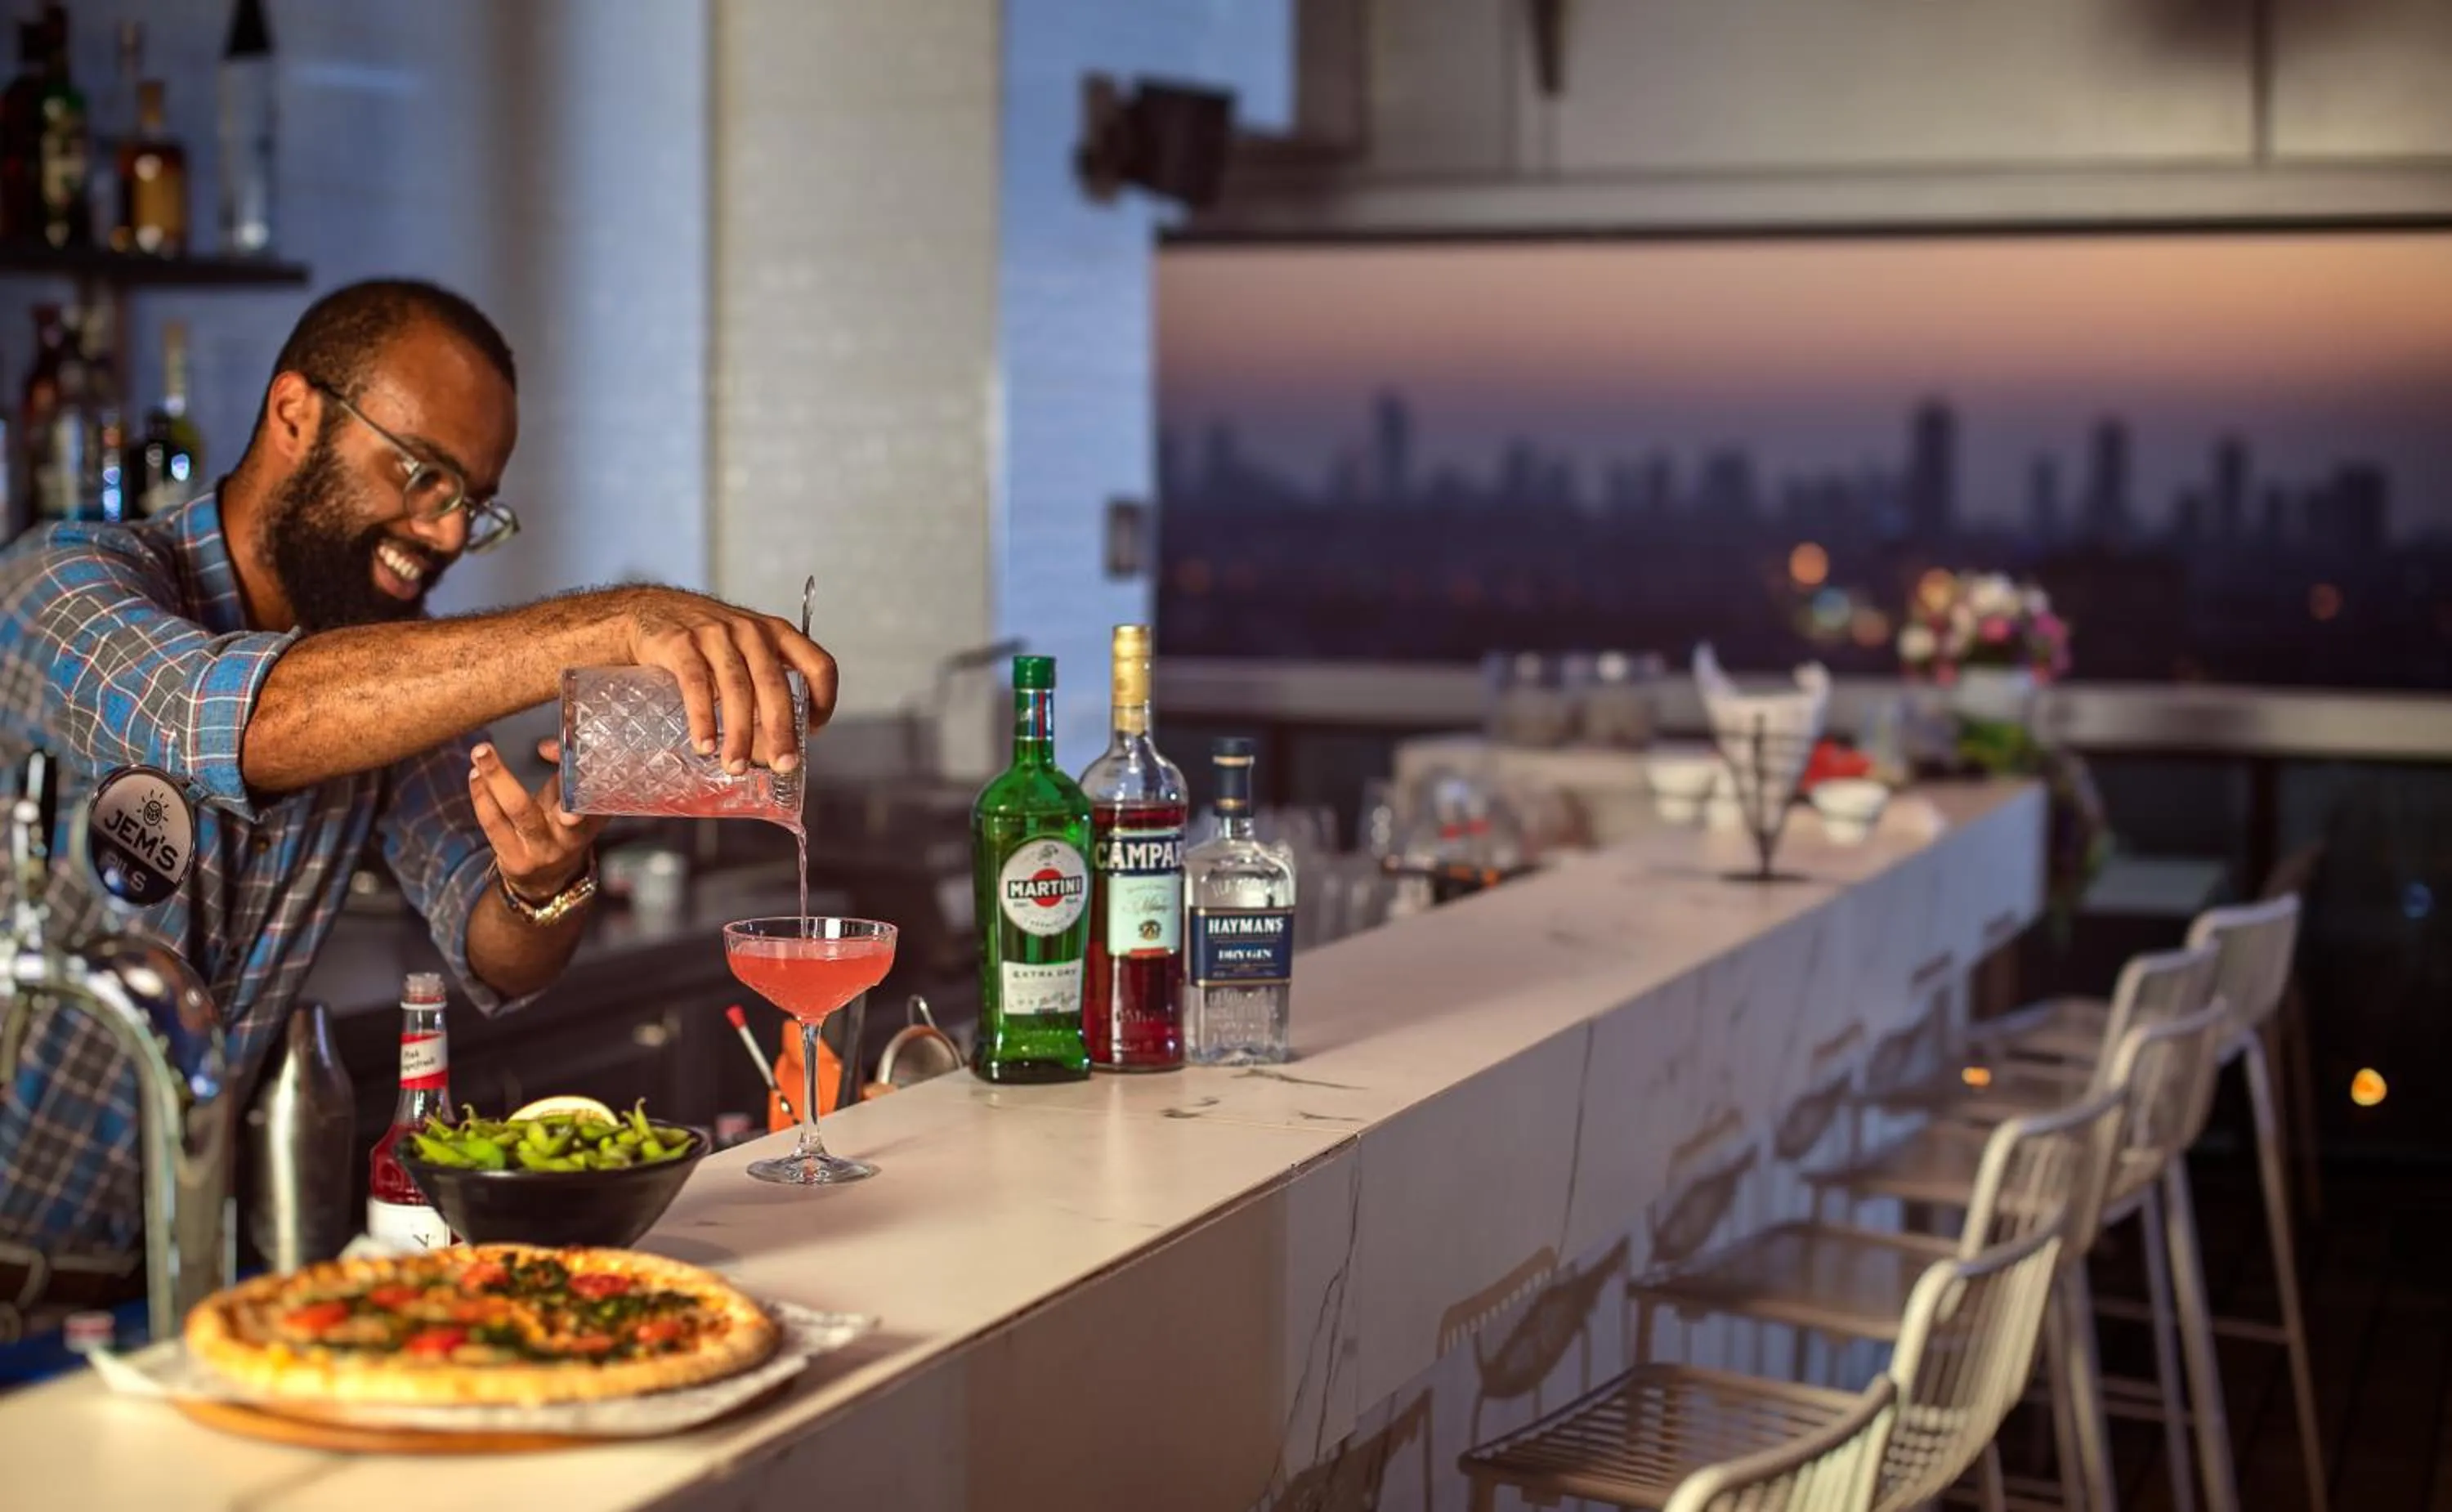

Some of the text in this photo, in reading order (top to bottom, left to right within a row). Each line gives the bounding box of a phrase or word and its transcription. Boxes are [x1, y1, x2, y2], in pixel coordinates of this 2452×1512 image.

[104, 808, 178, 872] JEM'S
[1009, 878, 1081, 897] MARTINI
[1218, 949, 1273, 961] DRY GIN
